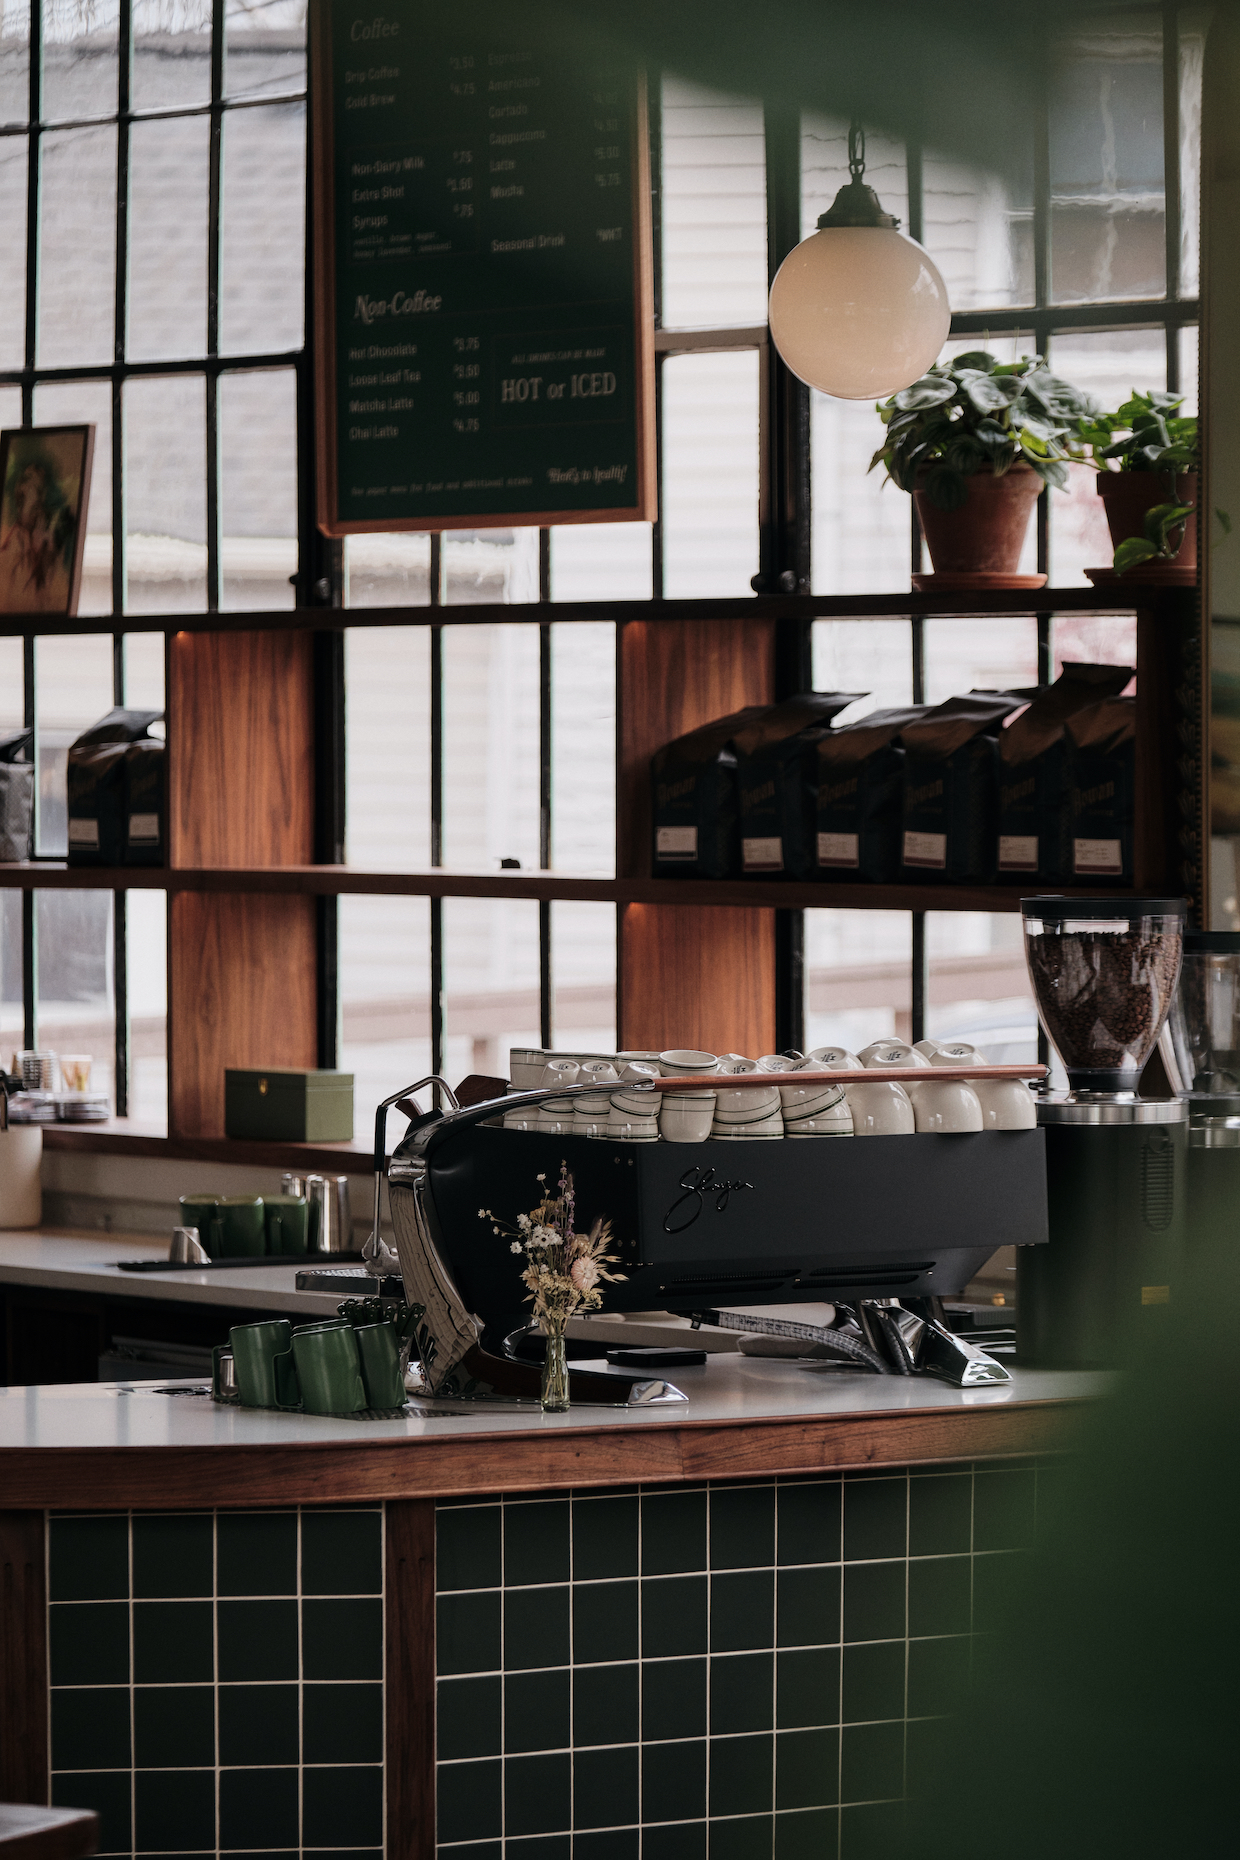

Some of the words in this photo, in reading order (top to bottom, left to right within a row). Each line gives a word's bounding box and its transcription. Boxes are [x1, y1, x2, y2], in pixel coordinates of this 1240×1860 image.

[350, 17, 400, 41] Coffee
[488, 52, 531, 66] Espresso
[345, 70, 366, 84] Drip
[367, 66, 400, 80] Coffee
[488, 77, 540, 91] Americano
[345, 95, 368, 110] Cold
[369, 94, 396, 107] Brew
[489, 102, 528, 119] Cortado
[489, 129, 546, 145] Cappuccino
[351, 159, 402, 176] Non-Dairy
[402, 156, 425, 171] Milk
[489, 159, 516, 173] Latte
[352, 188, 380, 203] Extra
[380, 185, 405, 200] Shot
[490, 183, 525, 199] Mocha
[352, 215, 389, 231] Syrups
[491, 235, 536, 253] Seasonal
[537, 232, 565, 248] Drink
[353, 289, 442, 325] Non-Coffee
[348, 347, 366, 361] Hot
[367, 342, 418, 360] Chocolate
[348, 373, 378, 387] Loose
[379, 369, 401, 386] Leaf
[403, 368, 421, 383] Tea
[501, 377, 543, 403] HOT
[547, 383, 566, 400] or
[570, 372, 617, 398] ICED
[348, 398, 387, 413] Matcha
[387, 397, 414, 411] Latte
[348, 425, 371, 441] Chai
[372, 424, 399, 439] Latte
